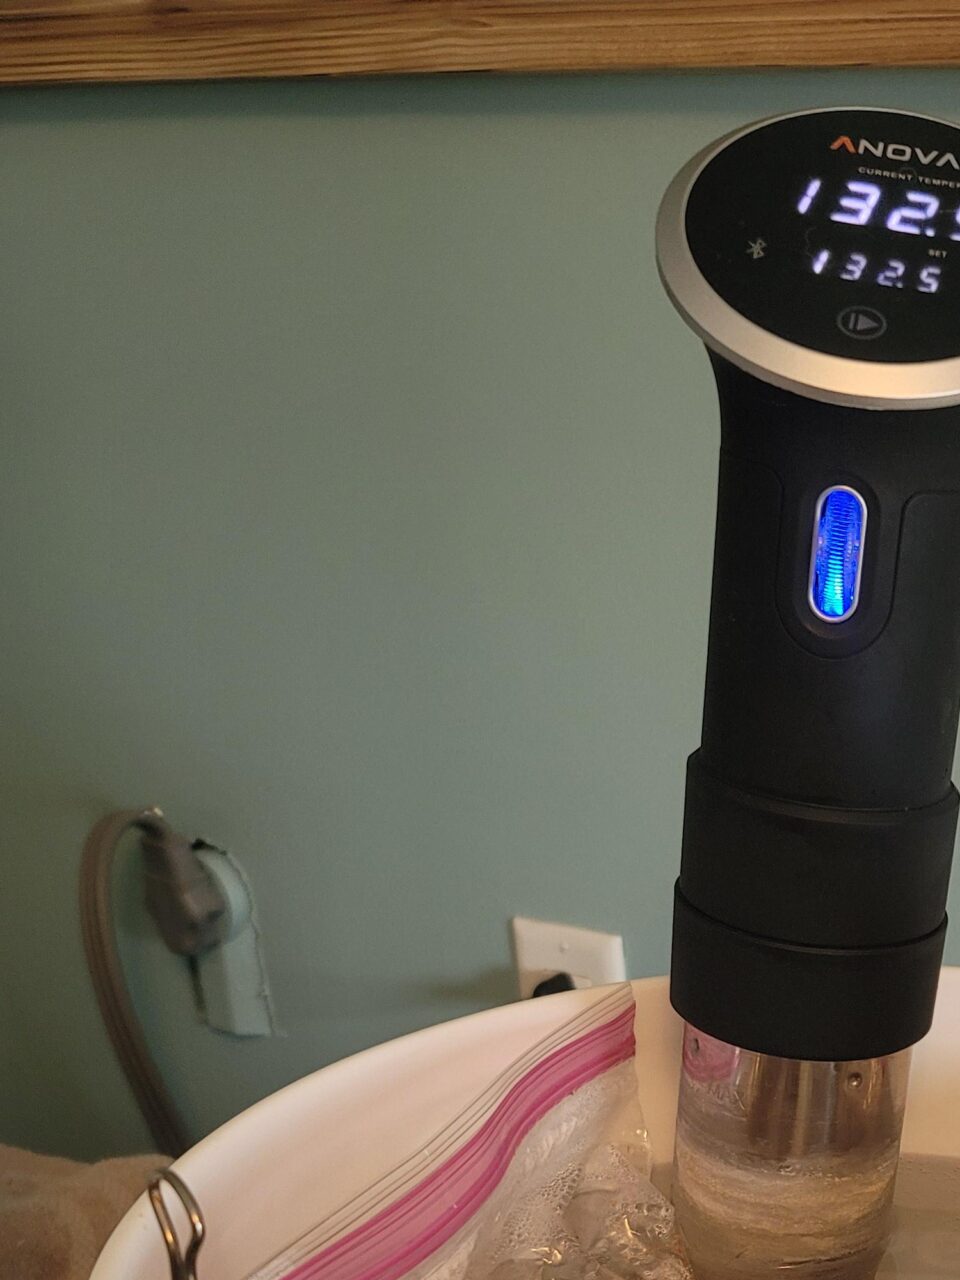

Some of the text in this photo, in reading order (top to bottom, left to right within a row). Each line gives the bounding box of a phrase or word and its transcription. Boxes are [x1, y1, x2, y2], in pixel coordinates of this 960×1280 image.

[829, 135, 960, 171] ANOVA
[857, 166, 912, 181] CURRENT
[928, 248, 948, 258] SET
[812, 248, 942, 294] 132.5
